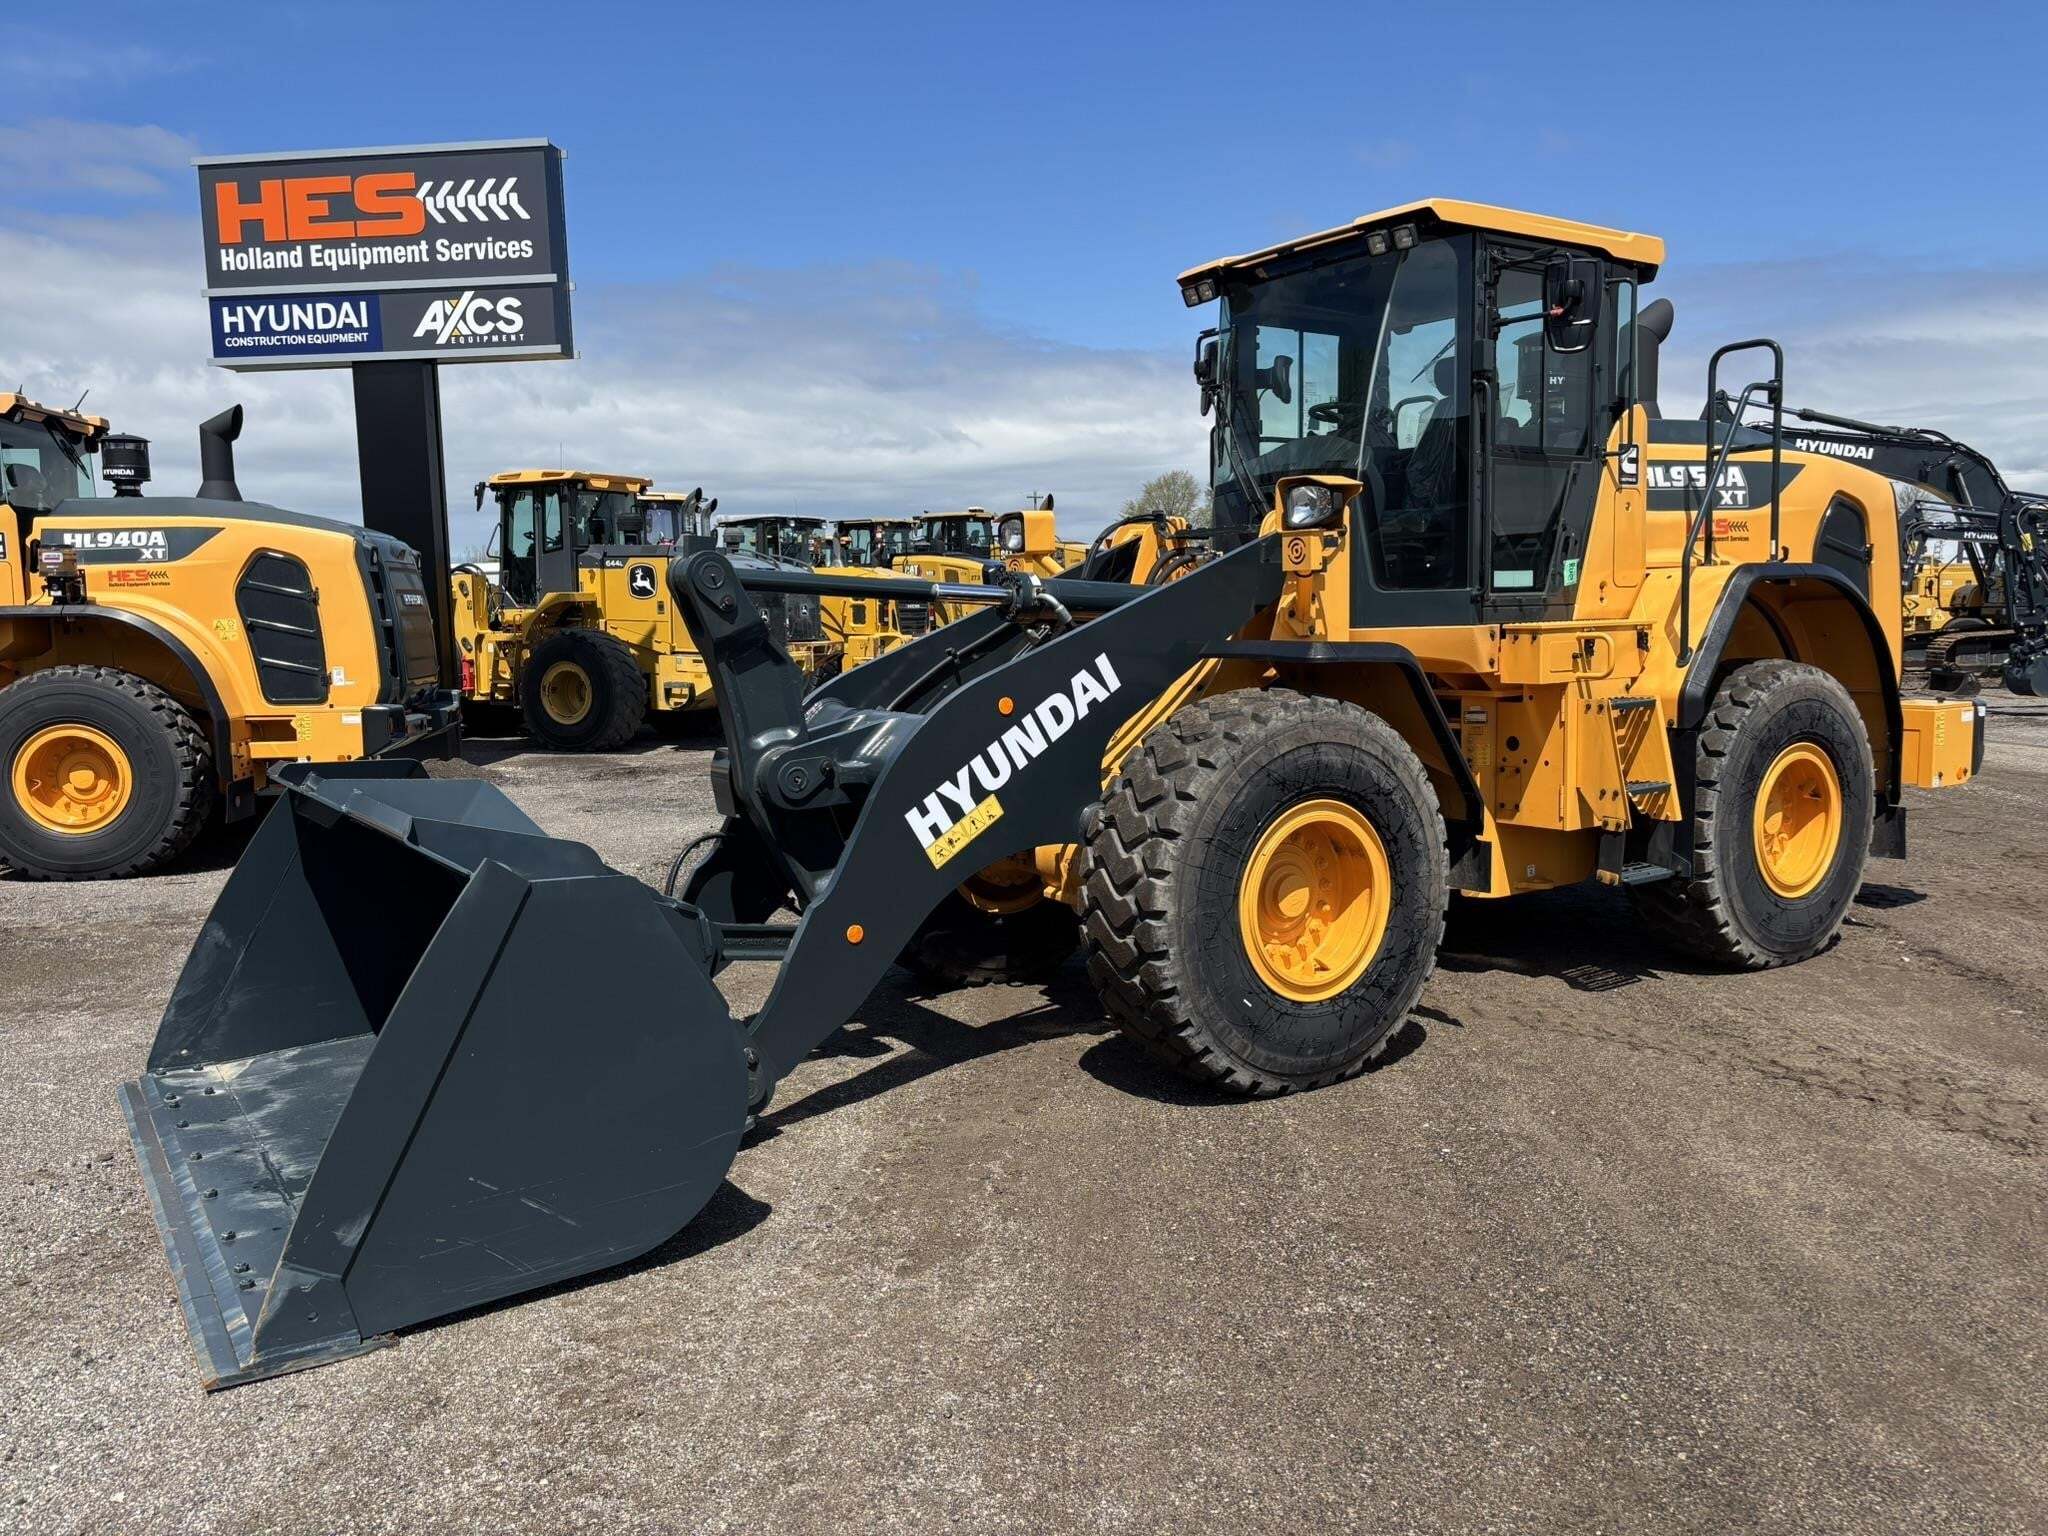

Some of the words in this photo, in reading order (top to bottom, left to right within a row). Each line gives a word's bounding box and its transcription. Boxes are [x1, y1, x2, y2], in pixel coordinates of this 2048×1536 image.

[215, 172, 426, 244] HES
[220, 245, 303, 271] Holland
[310, 239, 430, 271] Equipment
[435, 237, 534, 263] Services
[222, 301, 369, 333] HYUNDAI
[412, 291, 525, 345] AXCS
[225, 334, 306, 347] CONSTRUCTION
[307, 332, 368, 345] EQUIPMENT
[451, 333, 525, 344] EQUIPMENT
[1795, 438, 1874, 460] HYUNDAI
[1647, 465, 1746, 488] L95A
[1718, 490, 1746, 505] XT
[63, 531, 166, 548] HL940A
[140, 548, 166, 560] XT
[108, 569, 149, 582] HES
[904, 652, 1122, 850] HYUNDAI
